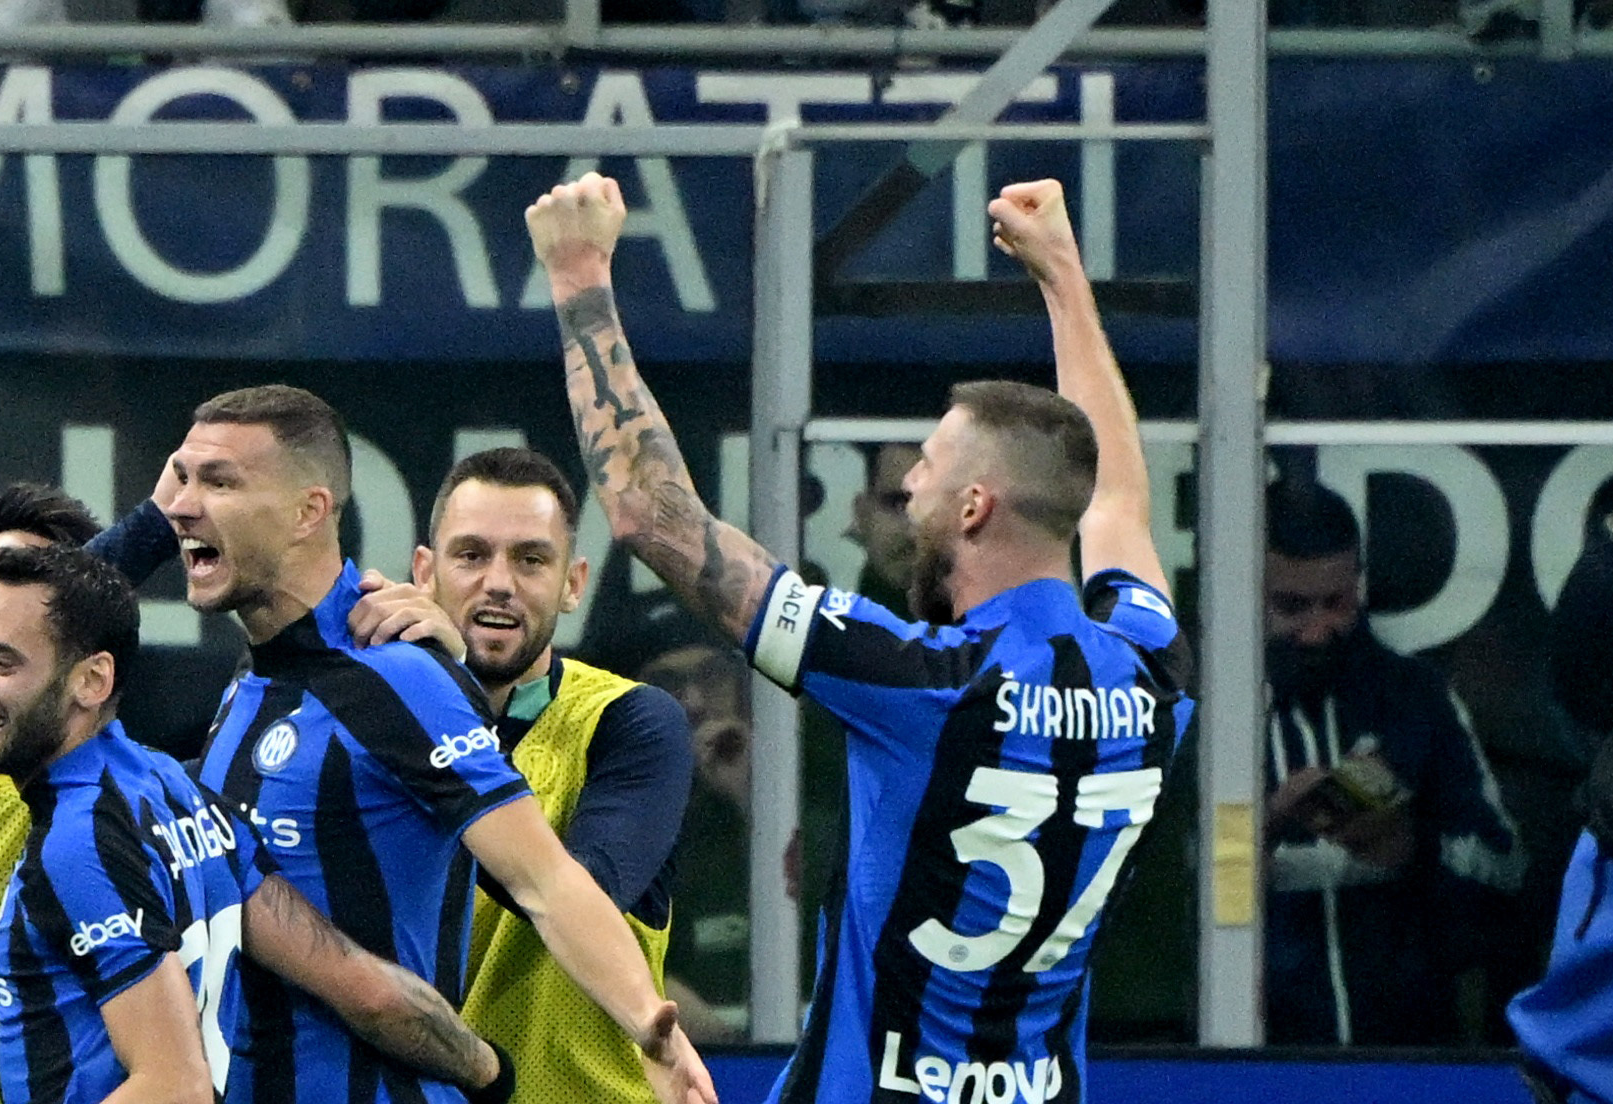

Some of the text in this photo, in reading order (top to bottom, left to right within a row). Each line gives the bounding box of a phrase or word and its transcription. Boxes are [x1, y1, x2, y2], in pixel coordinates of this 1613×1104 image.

[429, 724, 501, 769] ebay
[907, 766, 1162, 974] 37
[70, 908, 144, 957] ebay
